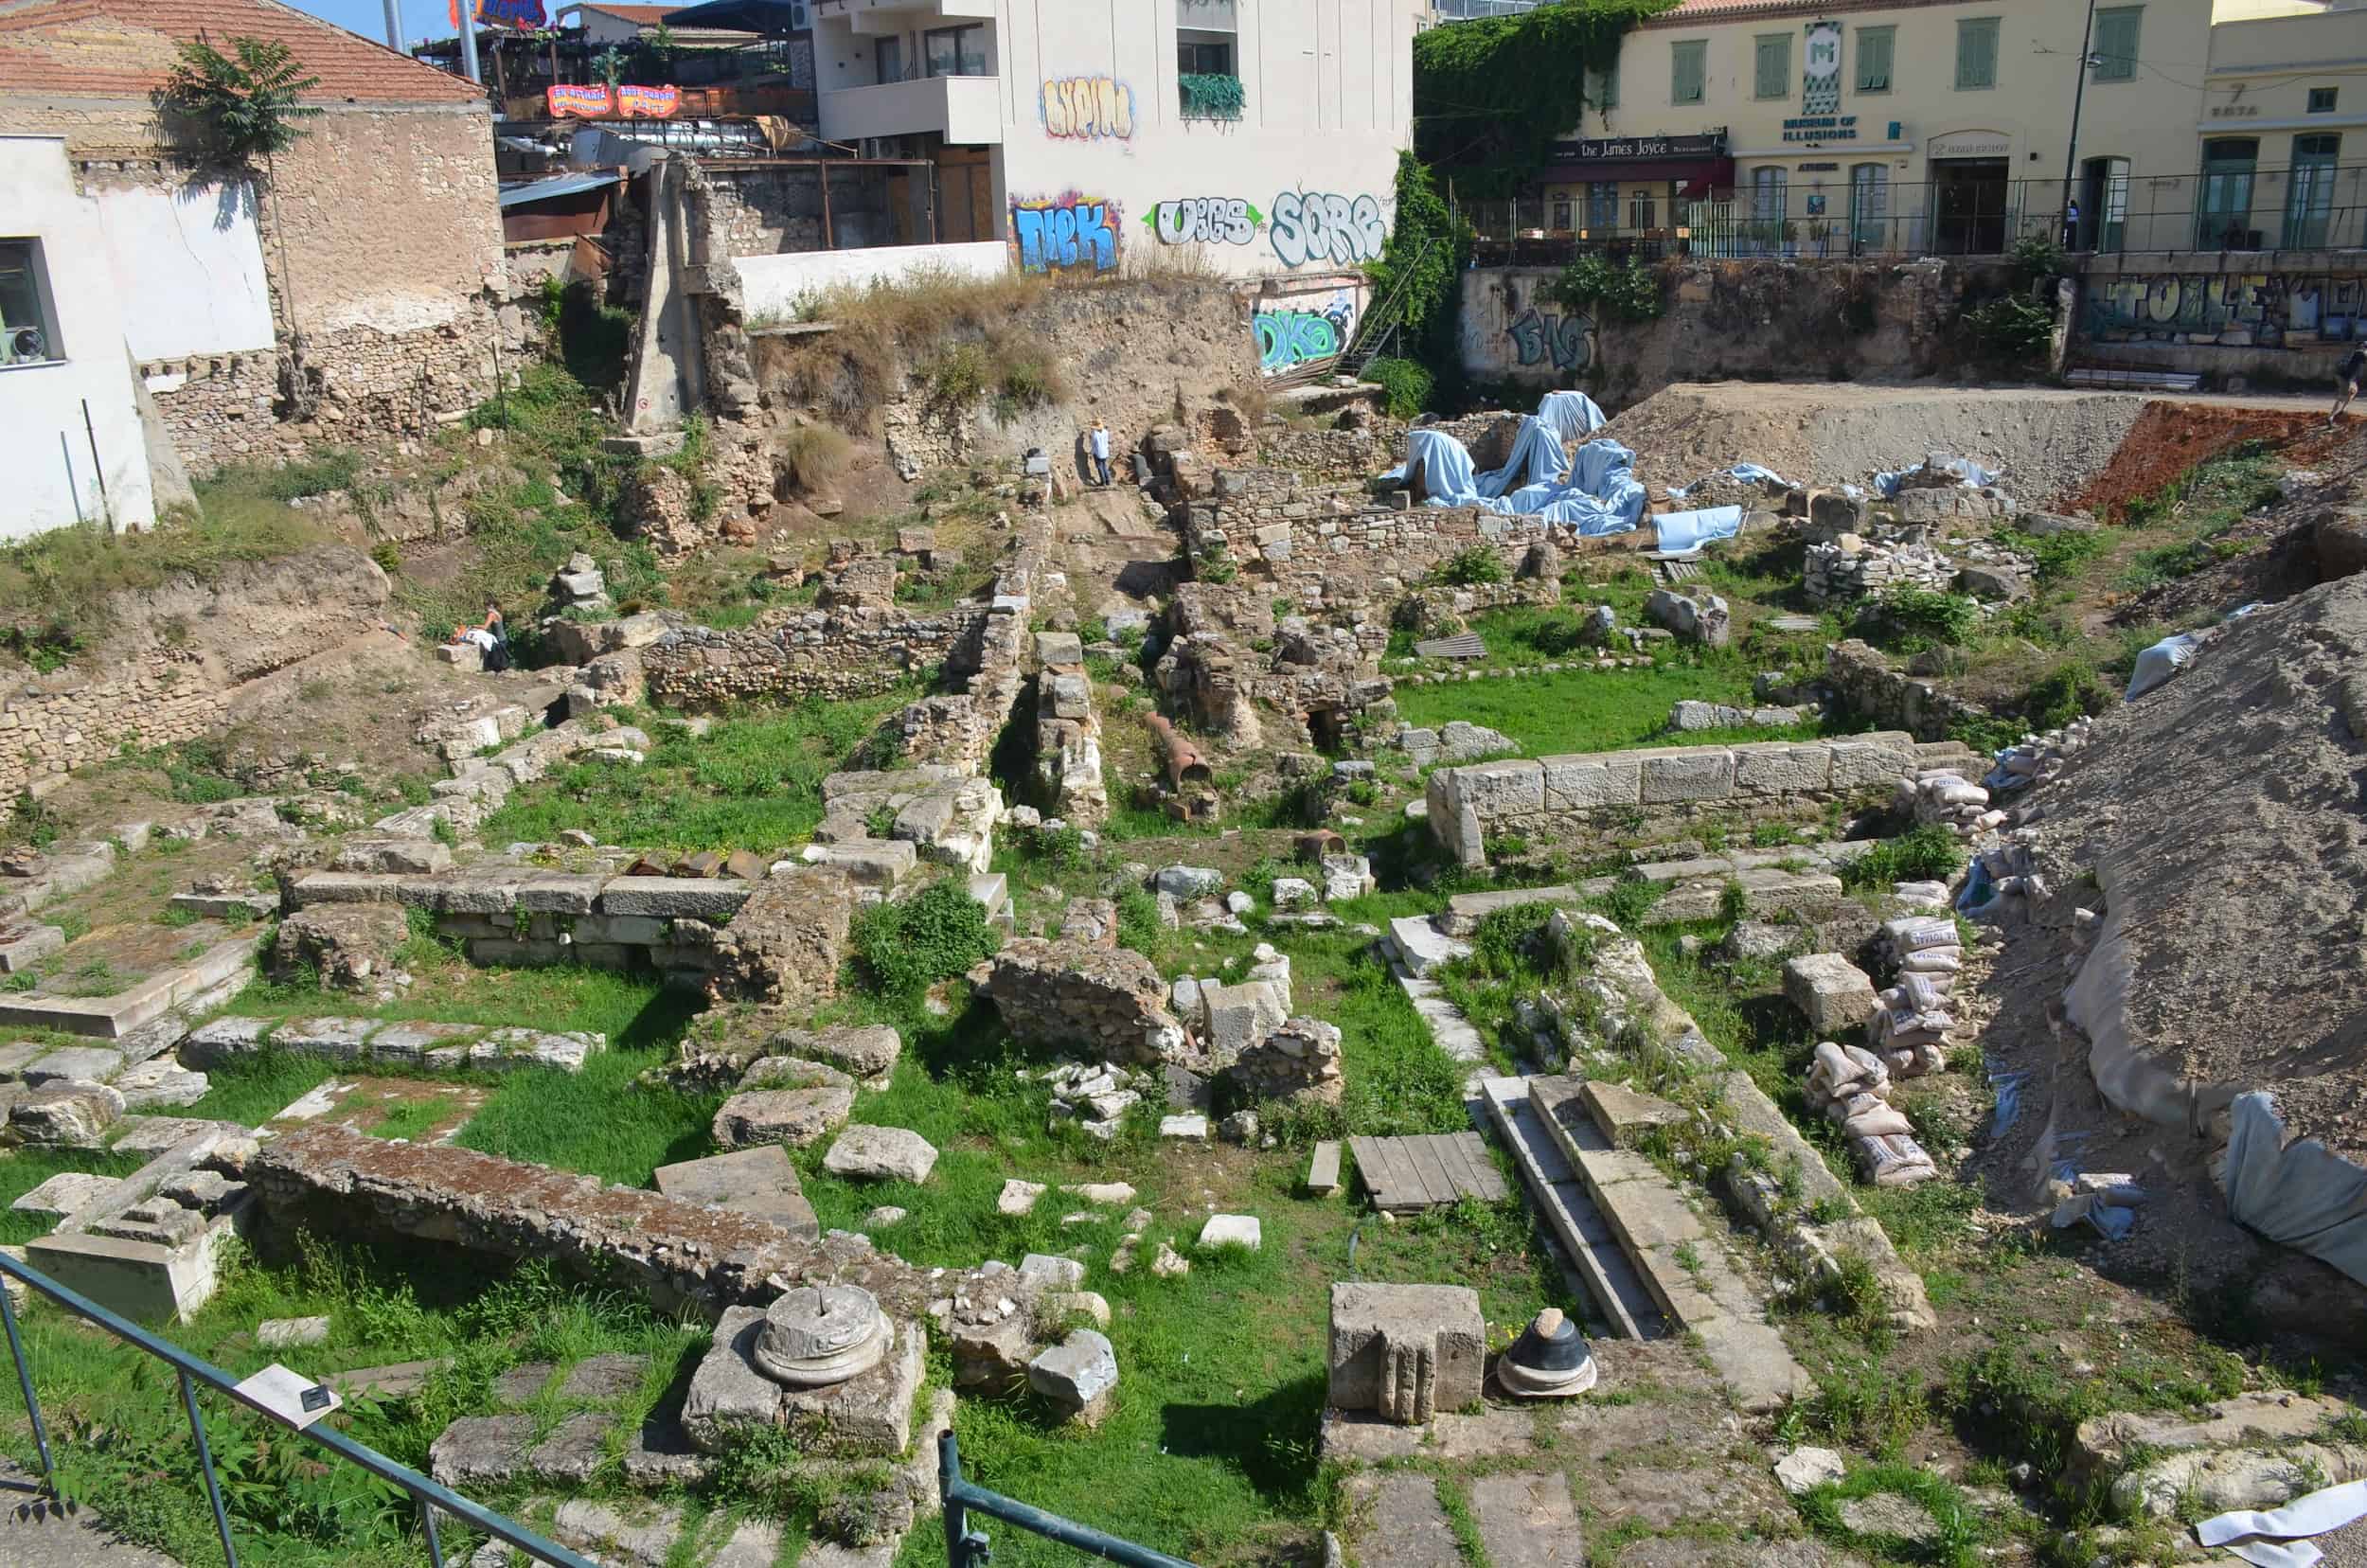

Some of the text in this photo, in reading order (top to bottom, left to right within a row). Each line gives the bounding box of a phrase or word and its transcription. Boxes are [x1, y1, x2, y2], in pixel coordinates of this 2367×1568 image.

[1784, 116, 1857, 130] MUSEUM OF
[1784, 129, 1857, 141] ILLUSIONS
[1602, 141, 1633, 157] James
[1636, 139, 1667, 155] Joyce
